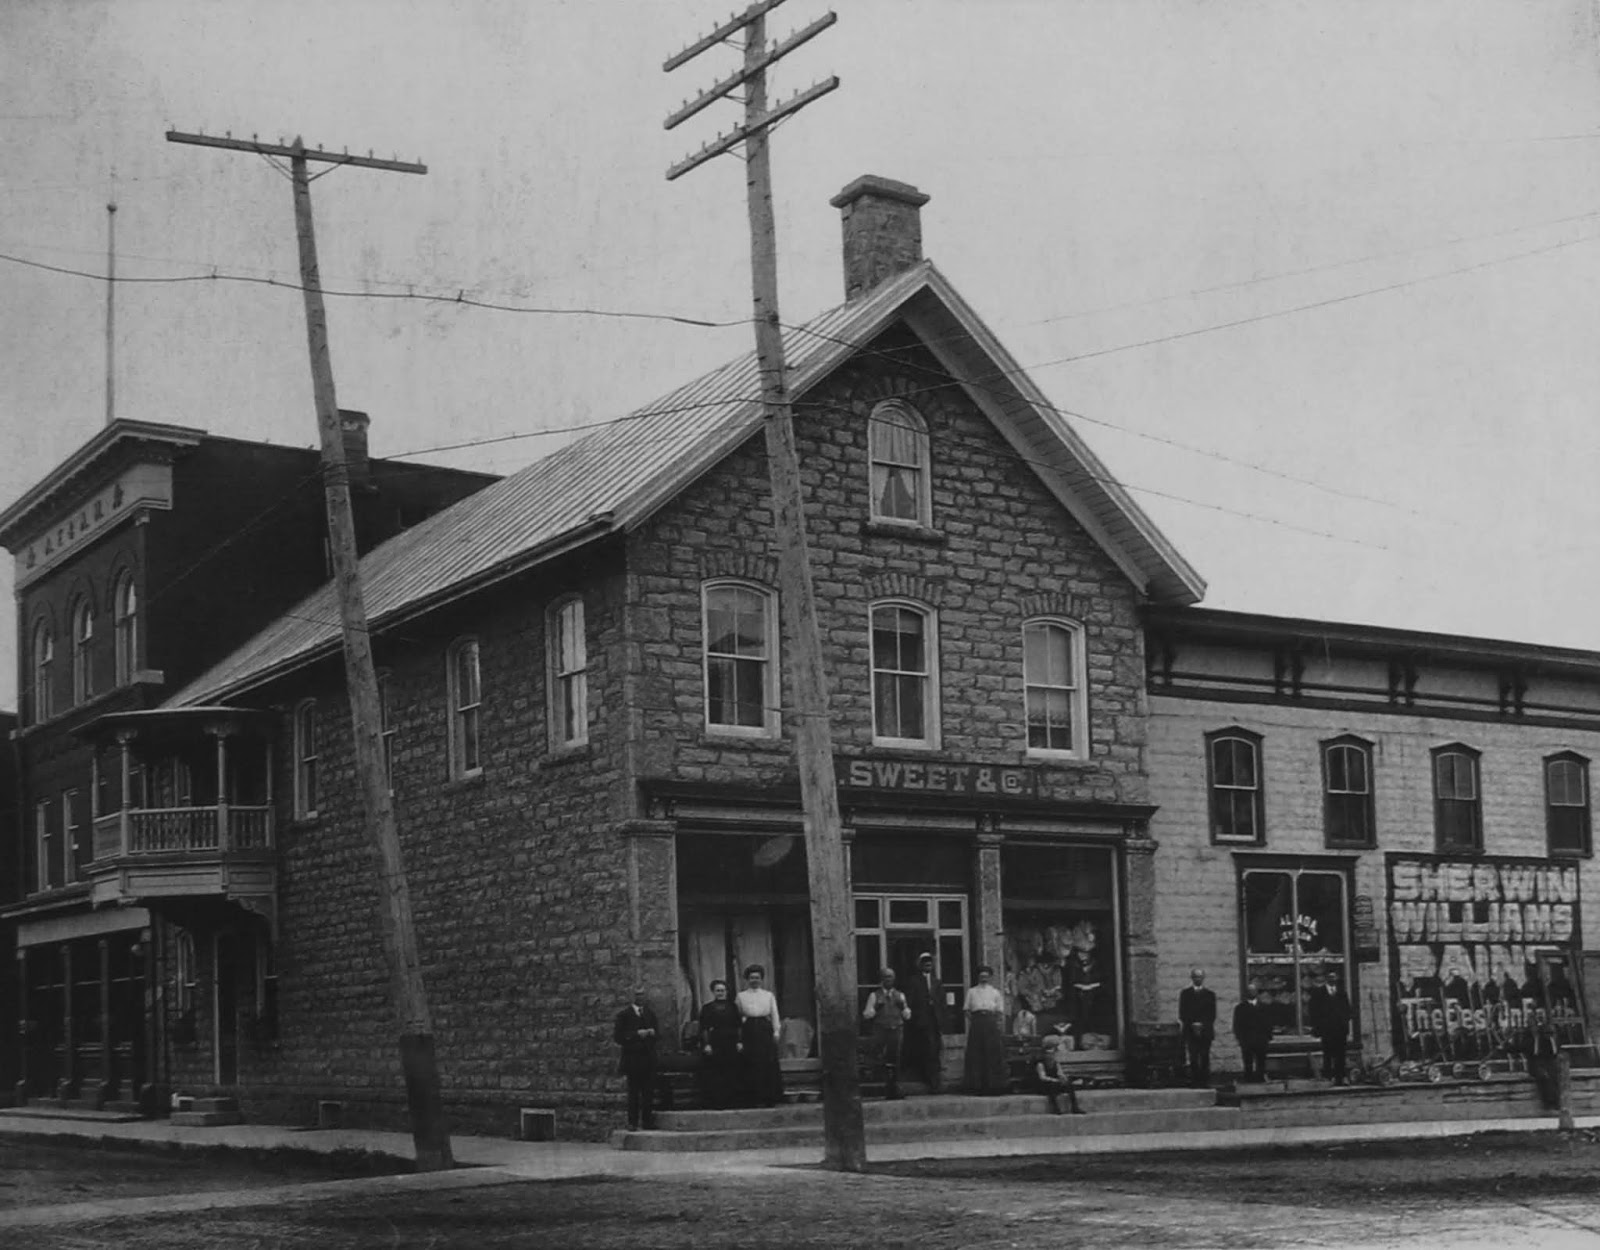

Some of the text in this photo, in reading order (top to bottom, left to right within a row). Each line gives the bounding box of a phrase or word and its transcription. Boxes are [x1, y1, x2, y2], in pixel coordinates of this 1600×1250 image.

[850, 760, 969, 792] SWEET
[976, 767, 997, 794] &
[1392, 860, 1577, 903] SHERWIN
[1391, 902, 1573, 942] WILLIAMS
[1400, 997, 1444, 1036] The
